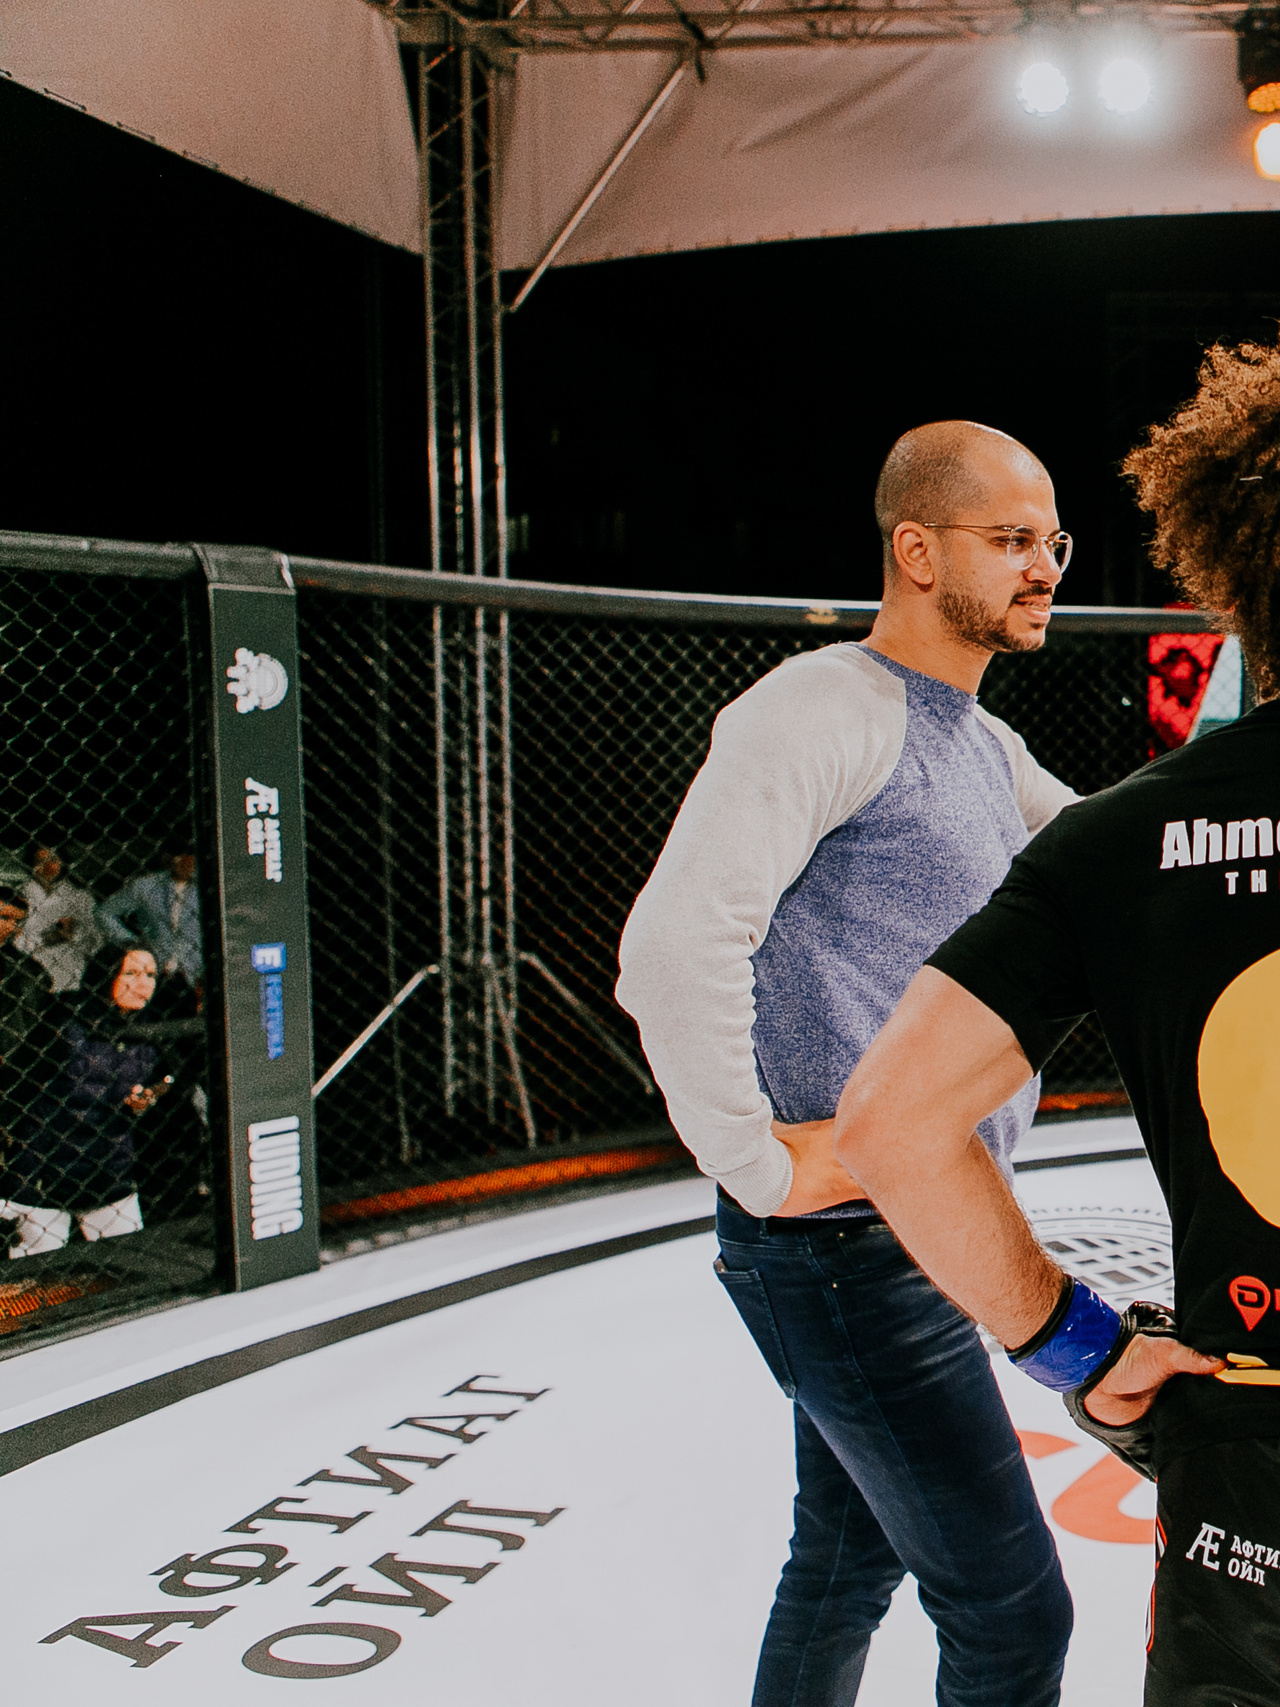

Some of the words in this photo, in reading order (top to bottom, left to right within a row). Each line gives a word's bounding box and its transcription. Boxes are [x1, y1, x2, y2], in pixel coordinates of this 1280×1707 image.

[248, 1115, 304, 1241] LUDING
[38, 1375, 555, 1669] АФТИАГ
[1227, 1557, 1266, 1587] ОЙЛ
